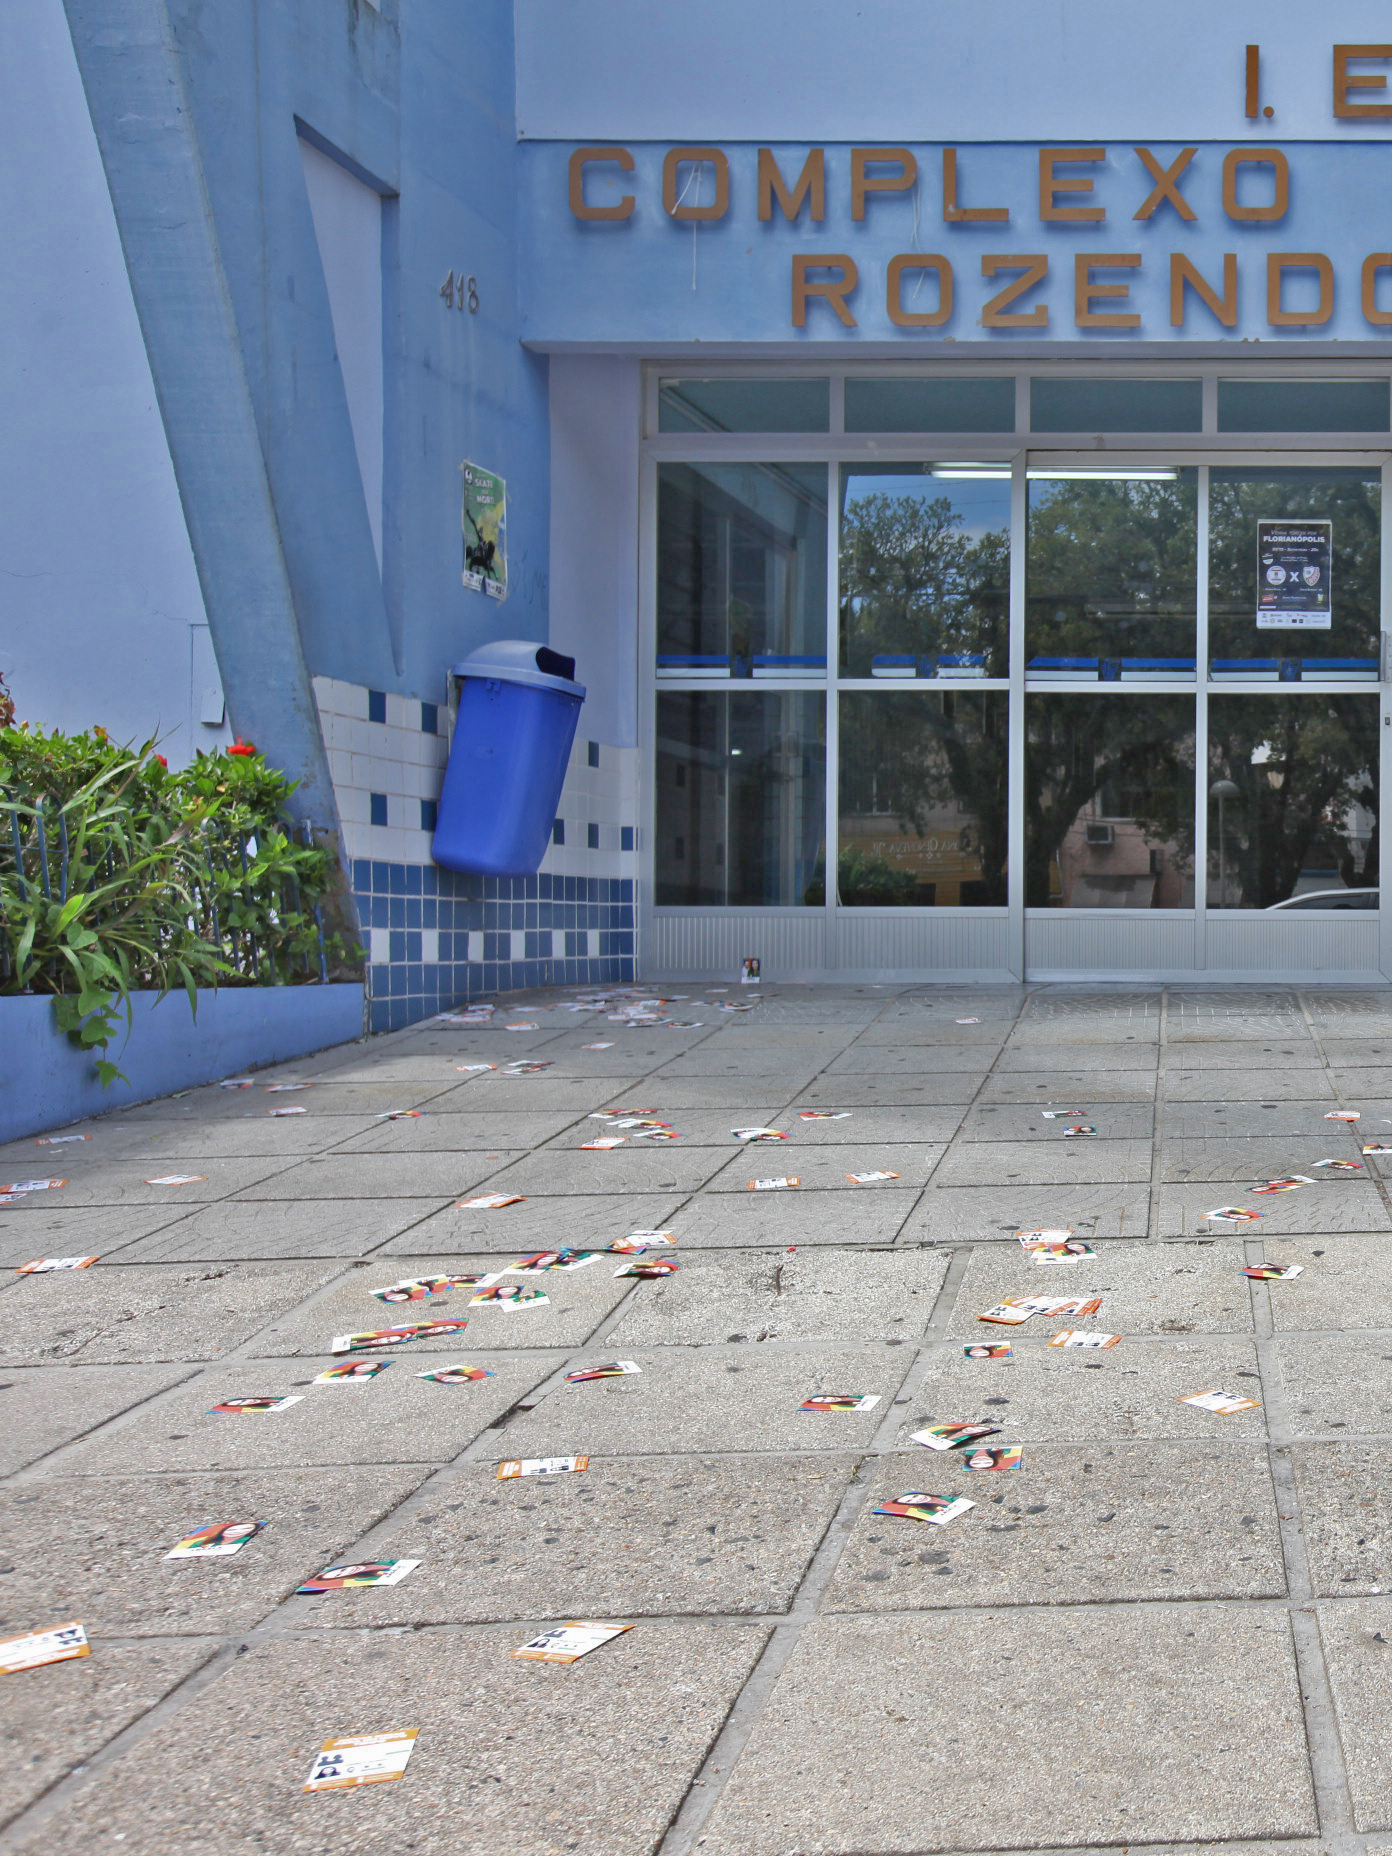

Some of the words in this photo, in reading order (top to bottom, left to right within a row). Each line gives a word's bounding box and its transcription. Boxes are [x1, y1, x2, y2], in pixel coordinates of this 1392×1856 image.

[568, 147, 1289, 221] COMPLEXO
[439, 269, 480, 314] 418
[1263, 534, 1325, 543] FLORIANÓPOLIS
